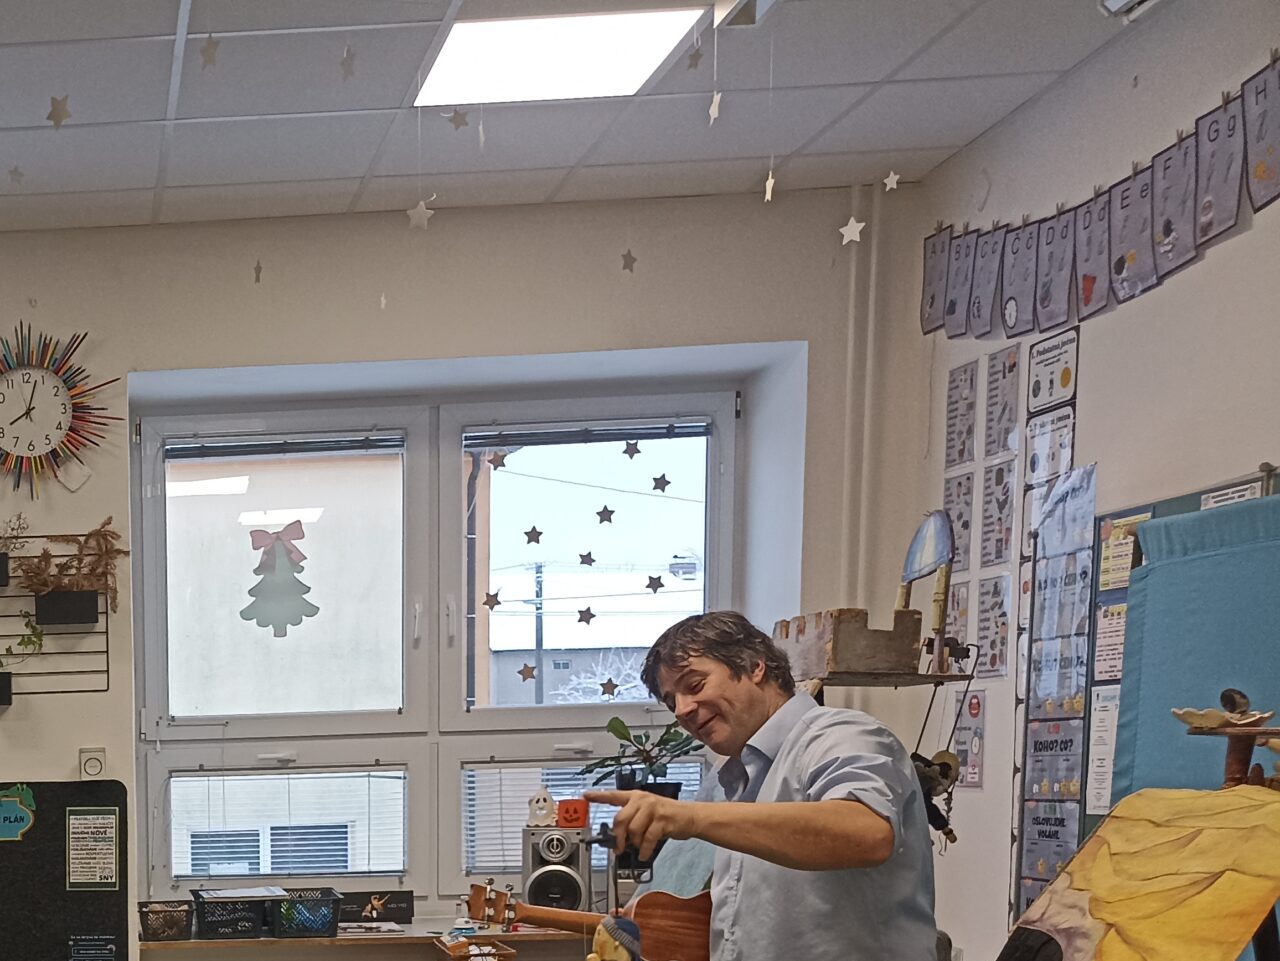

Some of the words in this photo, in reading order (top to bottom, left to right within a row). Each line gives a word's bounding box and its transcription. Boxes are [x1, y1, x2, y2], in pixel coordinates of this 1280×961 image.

[1255, 79, 1268, 105] H
[1207, 120, 1220, 142] G
[1227, 115, 1236, 138] g
[1163, 156, 1173, 180] F
[1120, 187, 1131, 209] E
[1140, 183, 1149, 199] e
[1046, 226, 1056, 246] D
[1061, 221, 1069, 239] d
[981, 241, 989, 259] C
[992, 241, 999, 254] c
[1011, 233, 1021, 255] Č
[954, 243, 961, 260] B
[21, 372, 32, 384] 12
[41, 375, 45, 385] 1
[6, 379, 14, 390] 11
[52, 385, 60, 397] 2
[60, 403, 67, 415] 3
[55, 421, 63, 431] 4
[12, 436, 20, 448] 7
[27, 440, 36, 452] 6
[44, 434, 52, 446] 5
[1033, 739, 1059, 753] KOHO?
[3, 813, 25, 824] PLÁN
